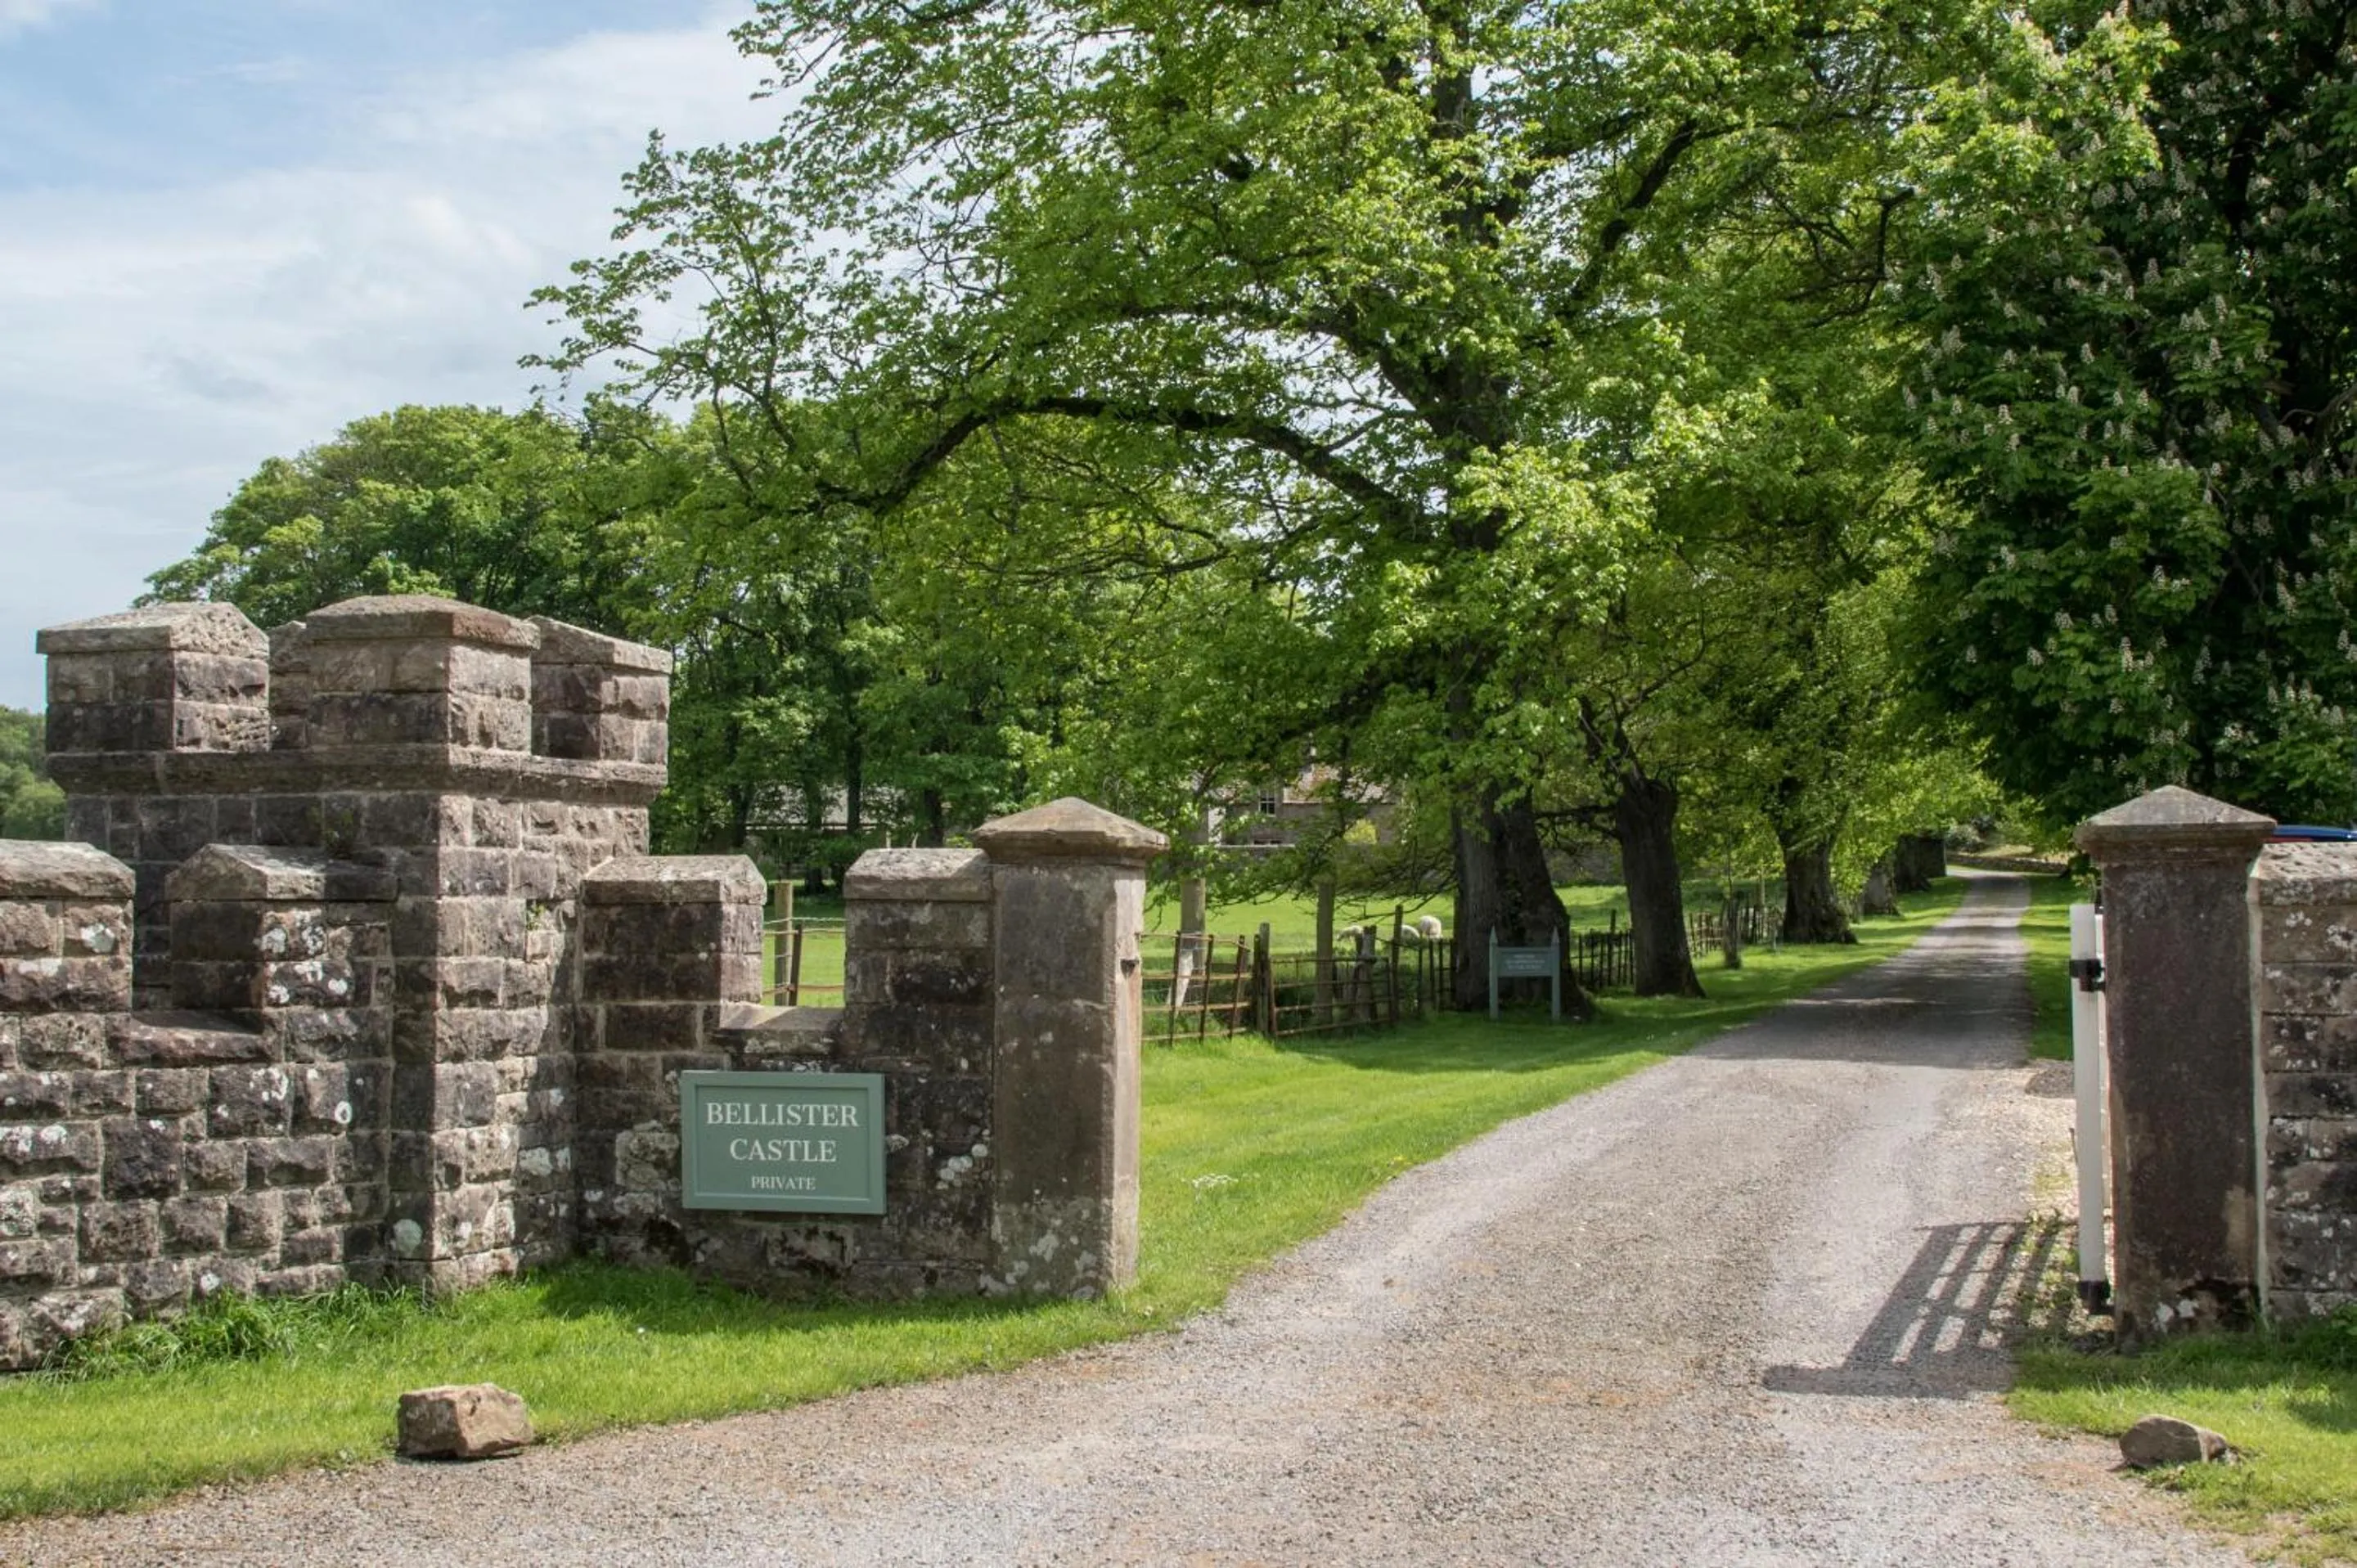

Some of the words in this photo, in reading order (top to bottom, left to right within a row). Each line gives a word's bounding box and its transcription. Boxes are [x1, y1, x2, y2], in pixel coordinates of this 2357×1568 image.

[706, 1102, 858, 1127] BELLISTER
[730, 1138, 836, 1162] CASTLE
[751, 1176, 816, 1191] PRIVATE
